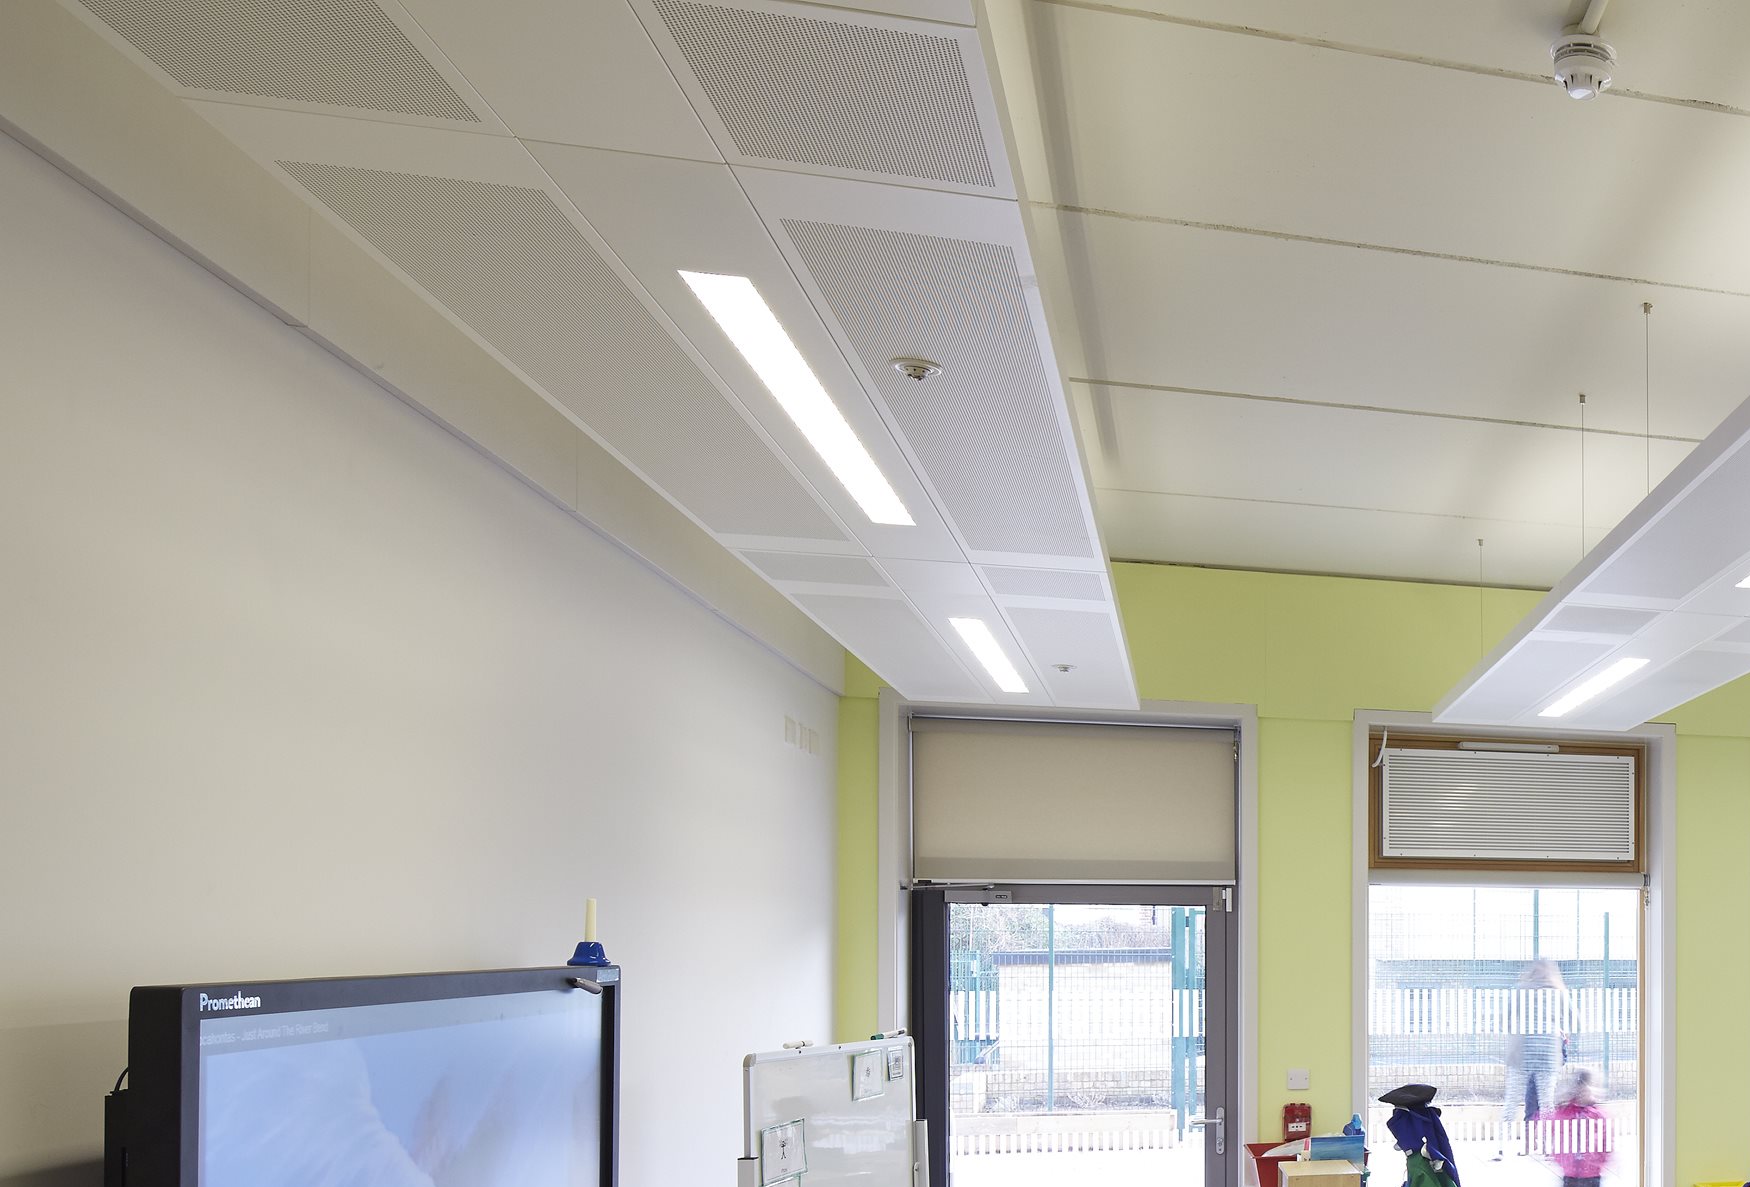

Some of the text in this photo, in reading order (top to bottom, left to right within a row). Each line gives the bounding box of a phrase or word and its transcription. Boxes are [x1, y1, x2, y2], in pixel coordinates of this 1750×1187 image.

[199, 991, 261, 1012] Promethean
[257, 1026, 280, 1040] Around
[281, 1025, 295, 1037] The
[296, 1023, 312, 1036] River
